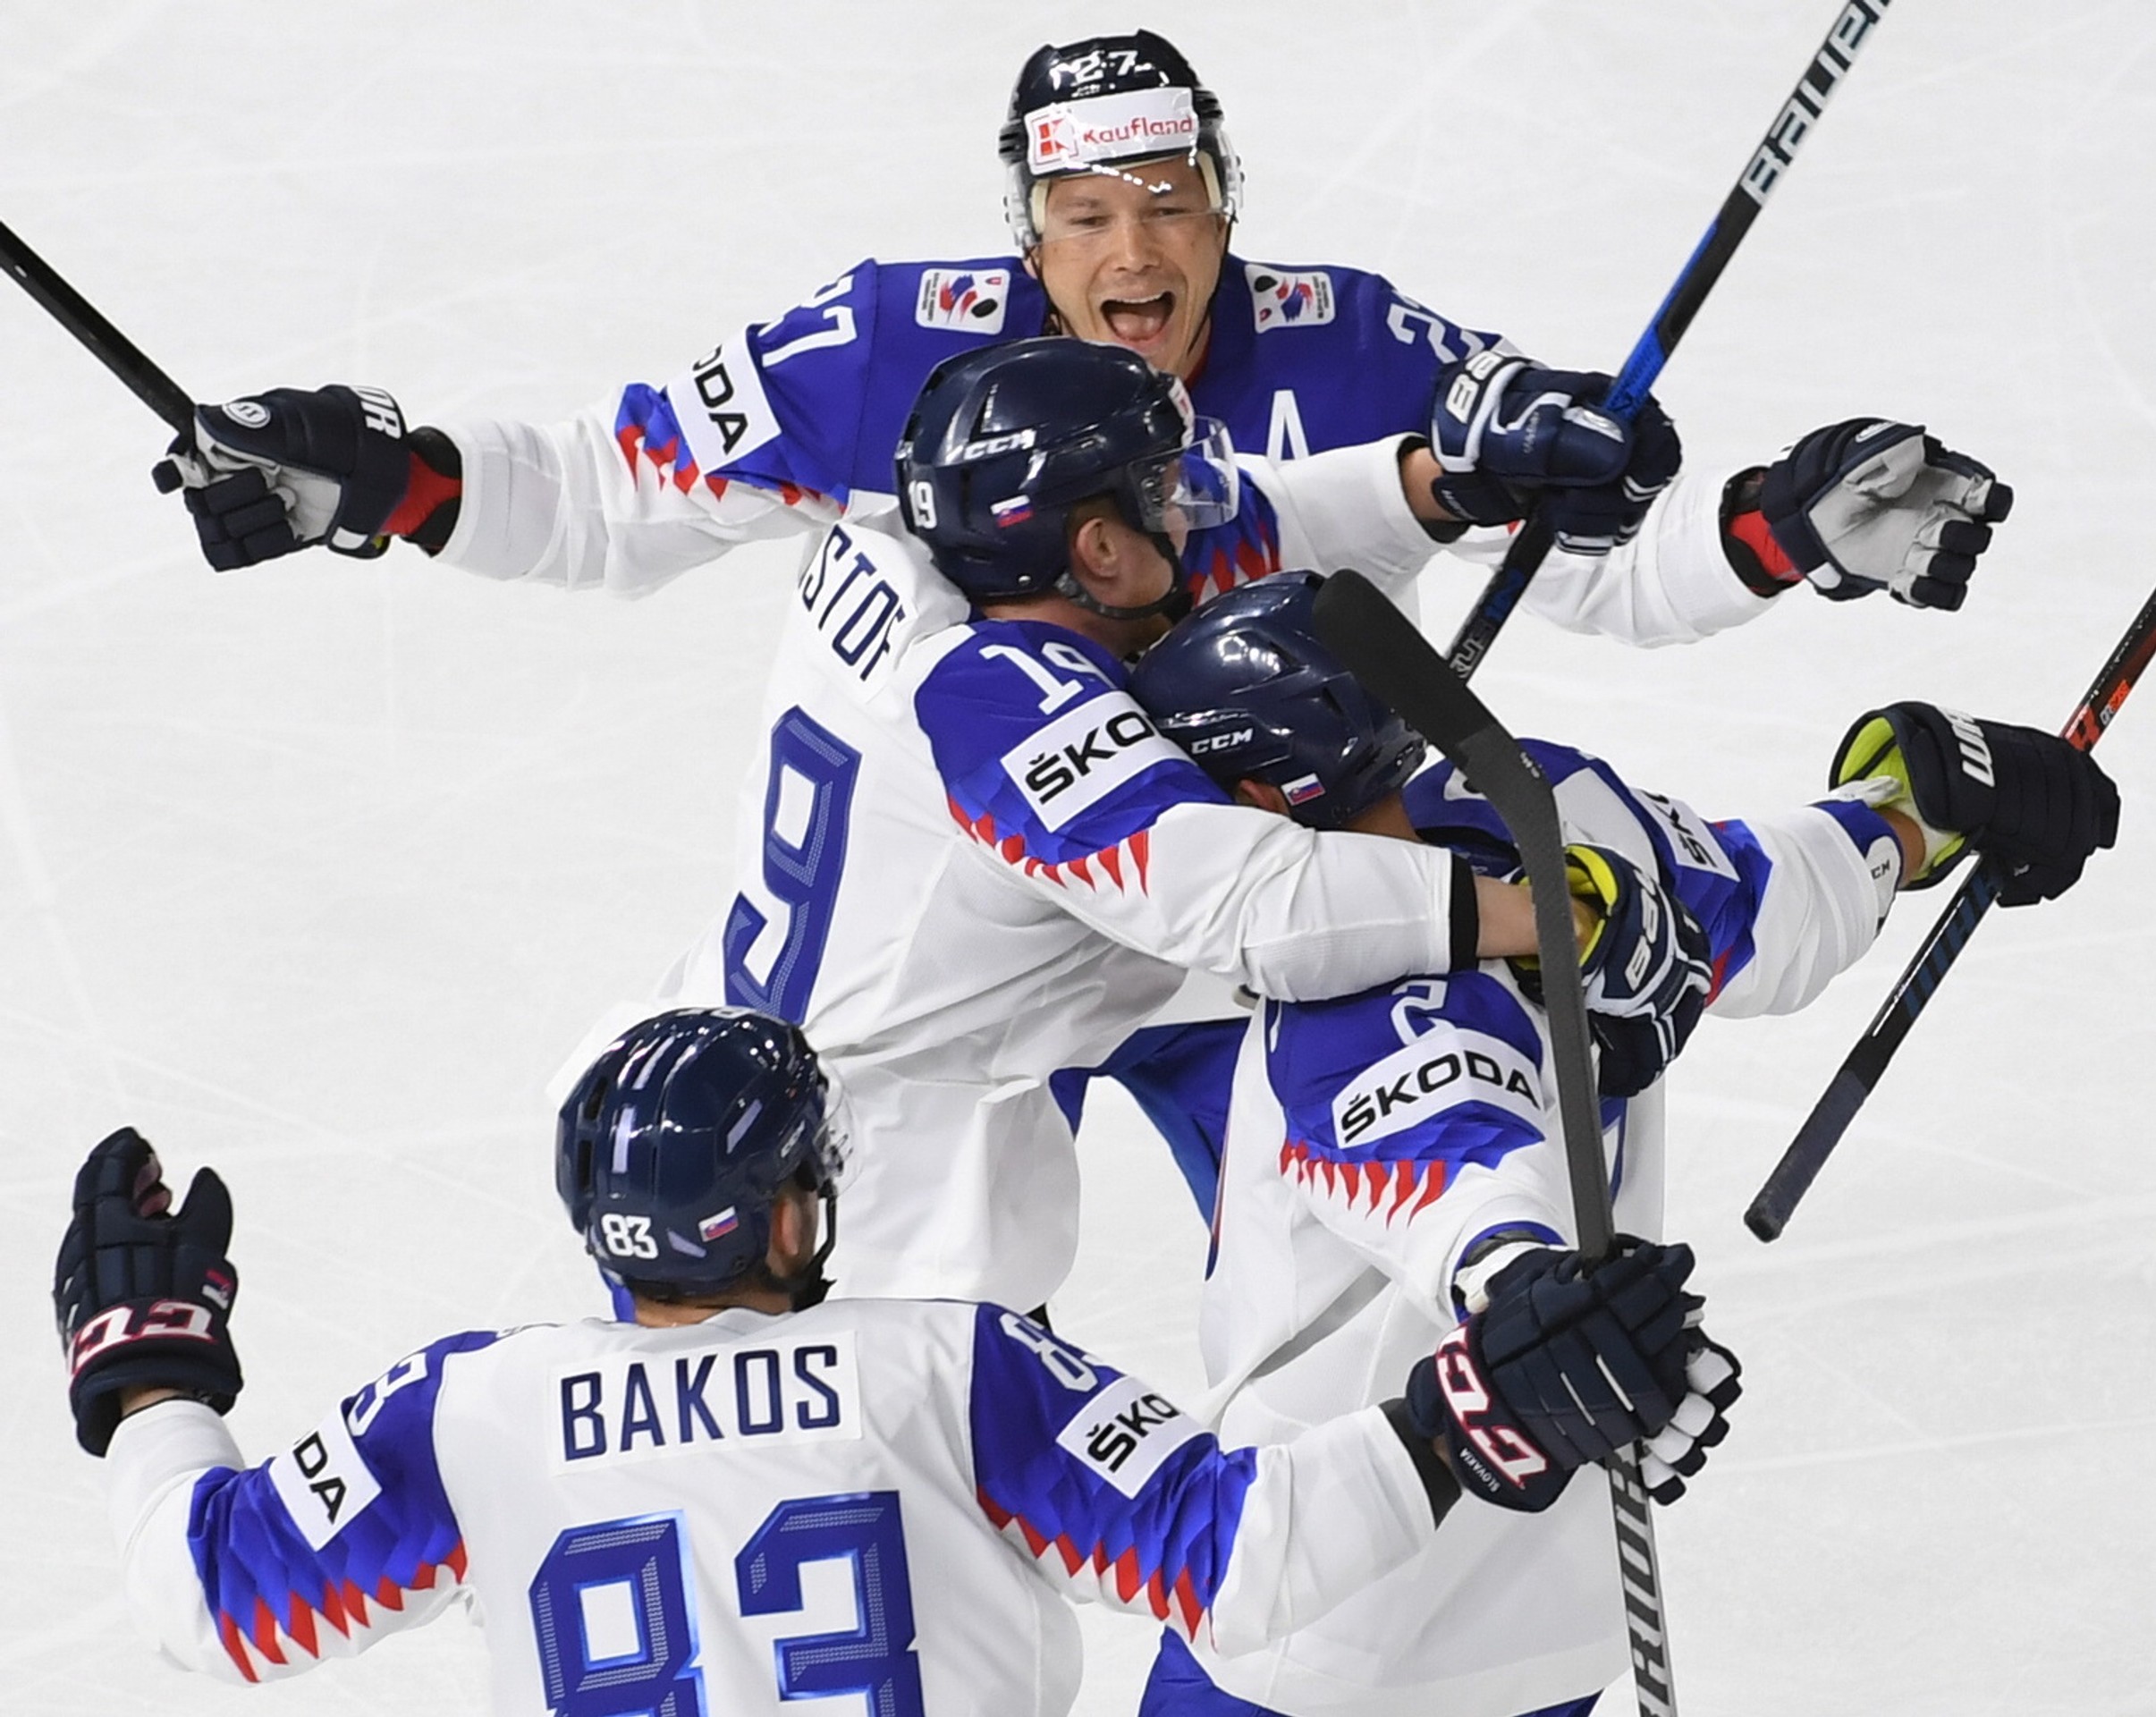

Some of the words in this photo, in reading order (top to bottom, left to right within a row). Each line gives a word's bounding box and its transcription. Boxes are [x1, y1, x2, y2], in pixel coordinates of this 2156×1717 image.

[1083, 116, 1194, 143] Kaufland
[963, 428, 1032, 461] CCM
[1267, 390, 1309, 461] A
[1025, 711, 1156, 806] ŠKO
[1191, 727, 1254, 755] CCM
[1340, 1050, 1542, 1144] ŠKODA
[600, 1213, 660, 1260] 83
[560, 1344, 841, 1462] BAKOS
[1458, 1446, 1501, 1493] SLOVAKIA
[528, 1490, 926, 1717] 83
